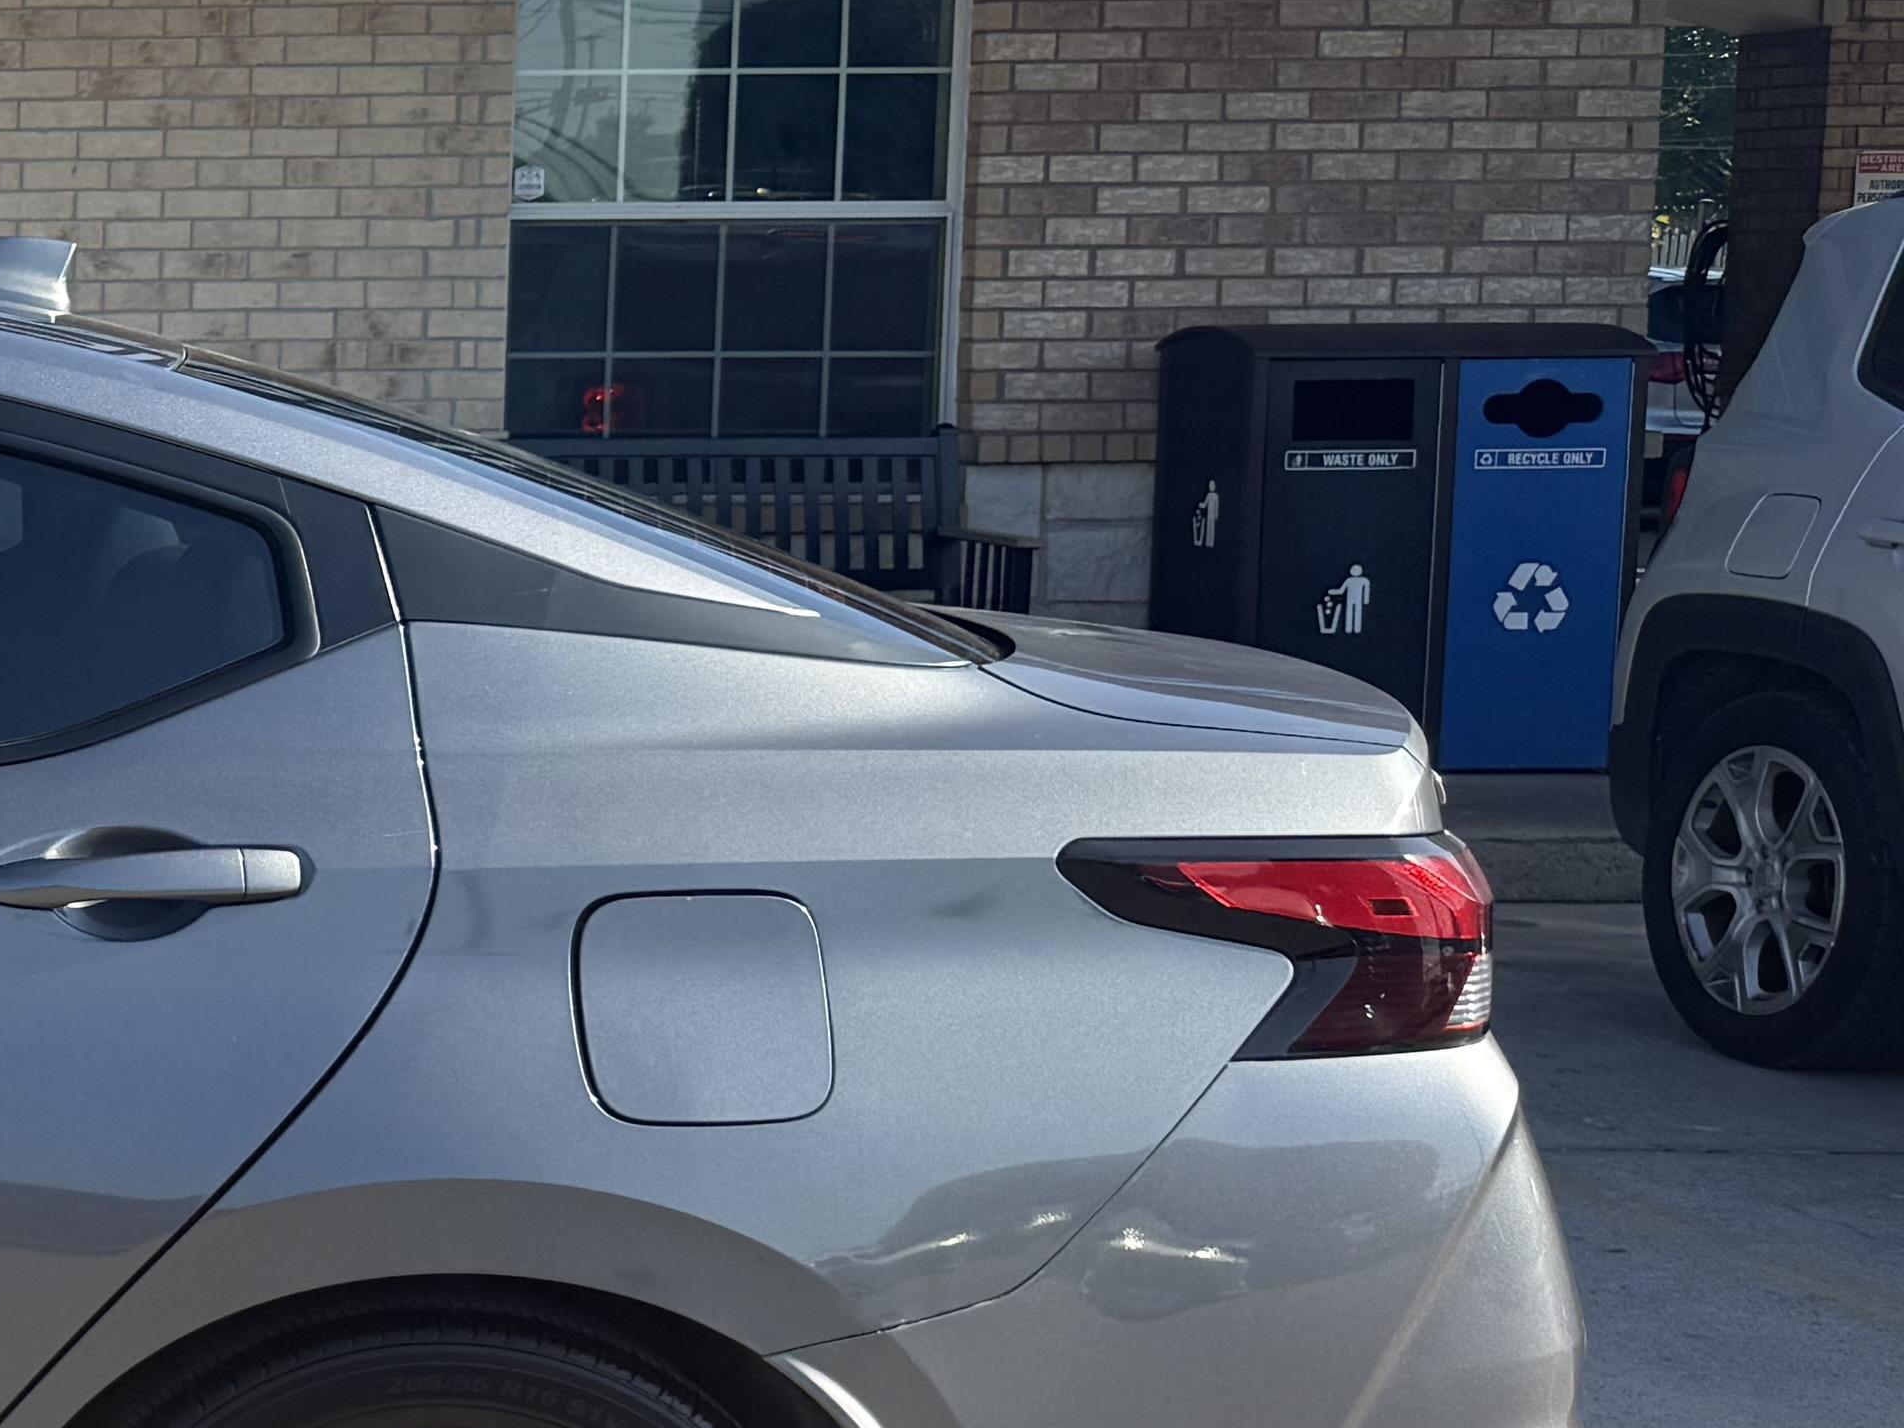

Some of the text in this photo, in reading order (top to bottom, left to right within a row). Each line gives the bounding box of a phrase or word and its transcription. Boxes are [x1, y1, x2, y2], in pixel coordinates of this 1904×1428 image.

[1322, 453, 1399, 467] WASTE ONLY
[1507, 452, 1593, 465] RECYCLE ONLY
